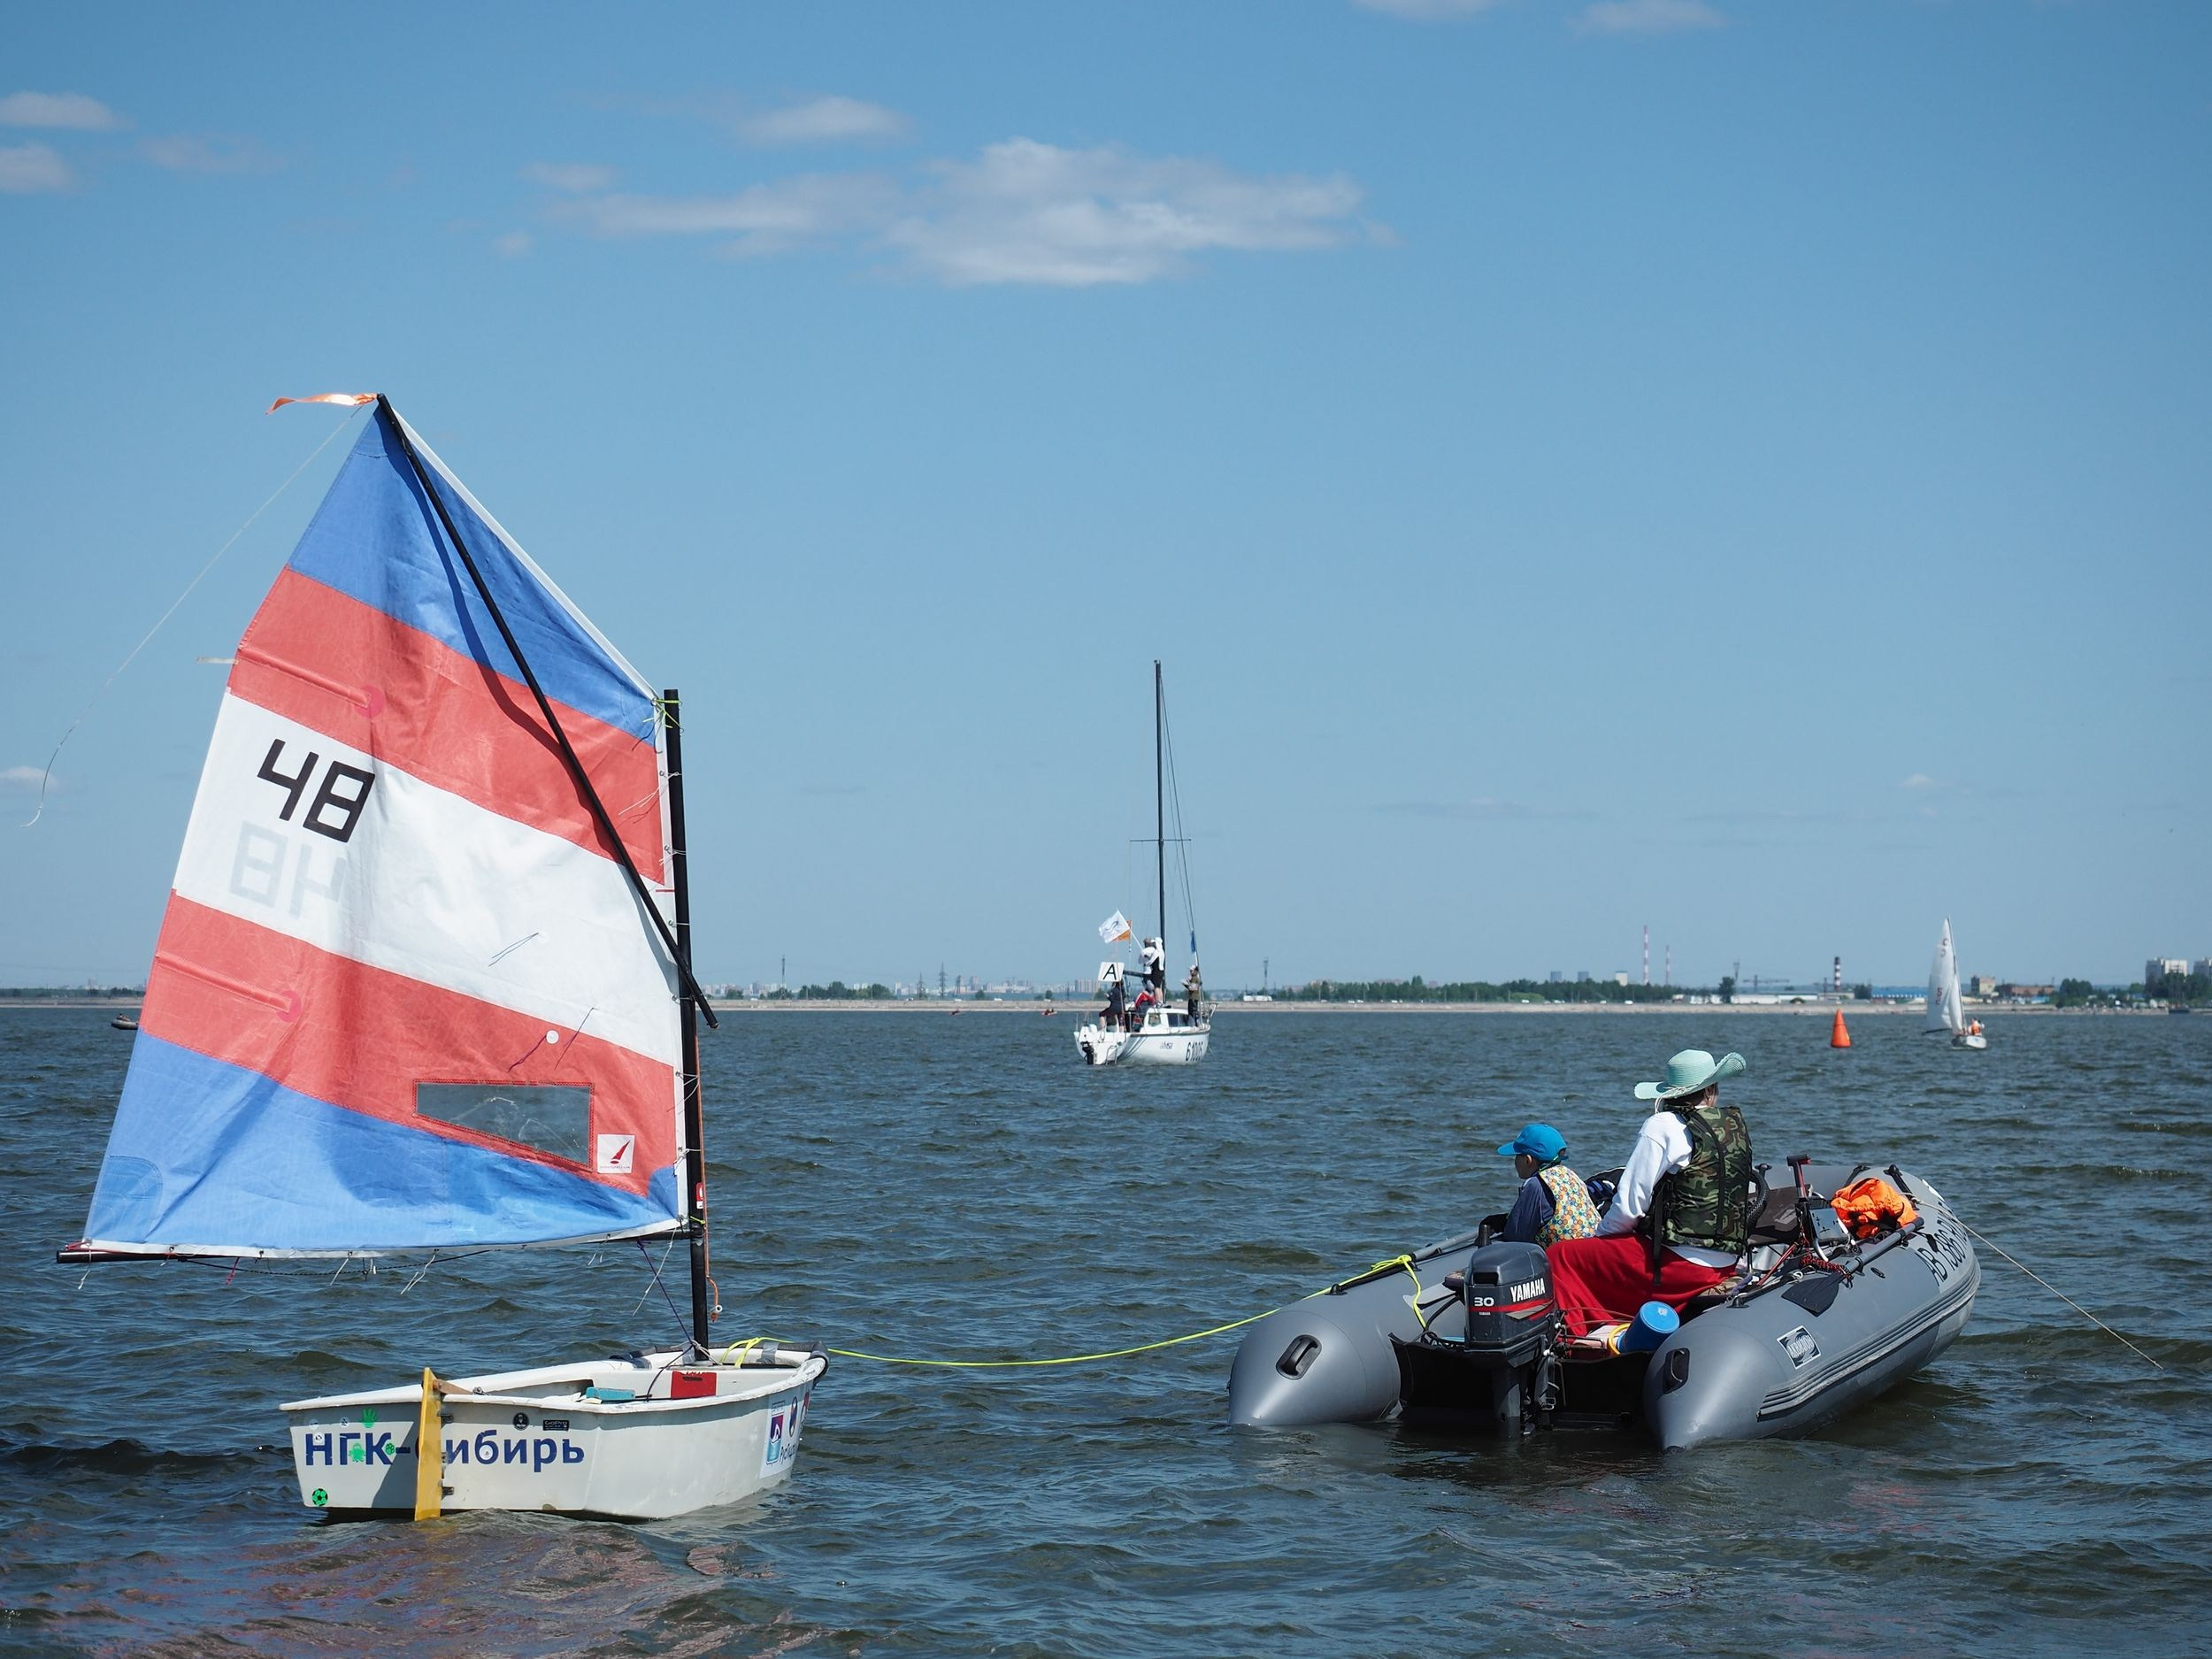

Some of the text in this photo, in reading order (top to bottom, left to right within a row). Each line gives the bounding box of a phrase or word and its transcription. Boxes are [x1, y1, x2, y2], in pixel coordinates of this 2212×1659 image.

[257, 738, 376, 843] 48
[1102, 964, 1118, 980] A
[1473, 1296, 1494, 1307] 30
[1509, 1277, 1546, 1303] YAMAHA
[305, 1429, 585, 1473] НГК-ибирь
